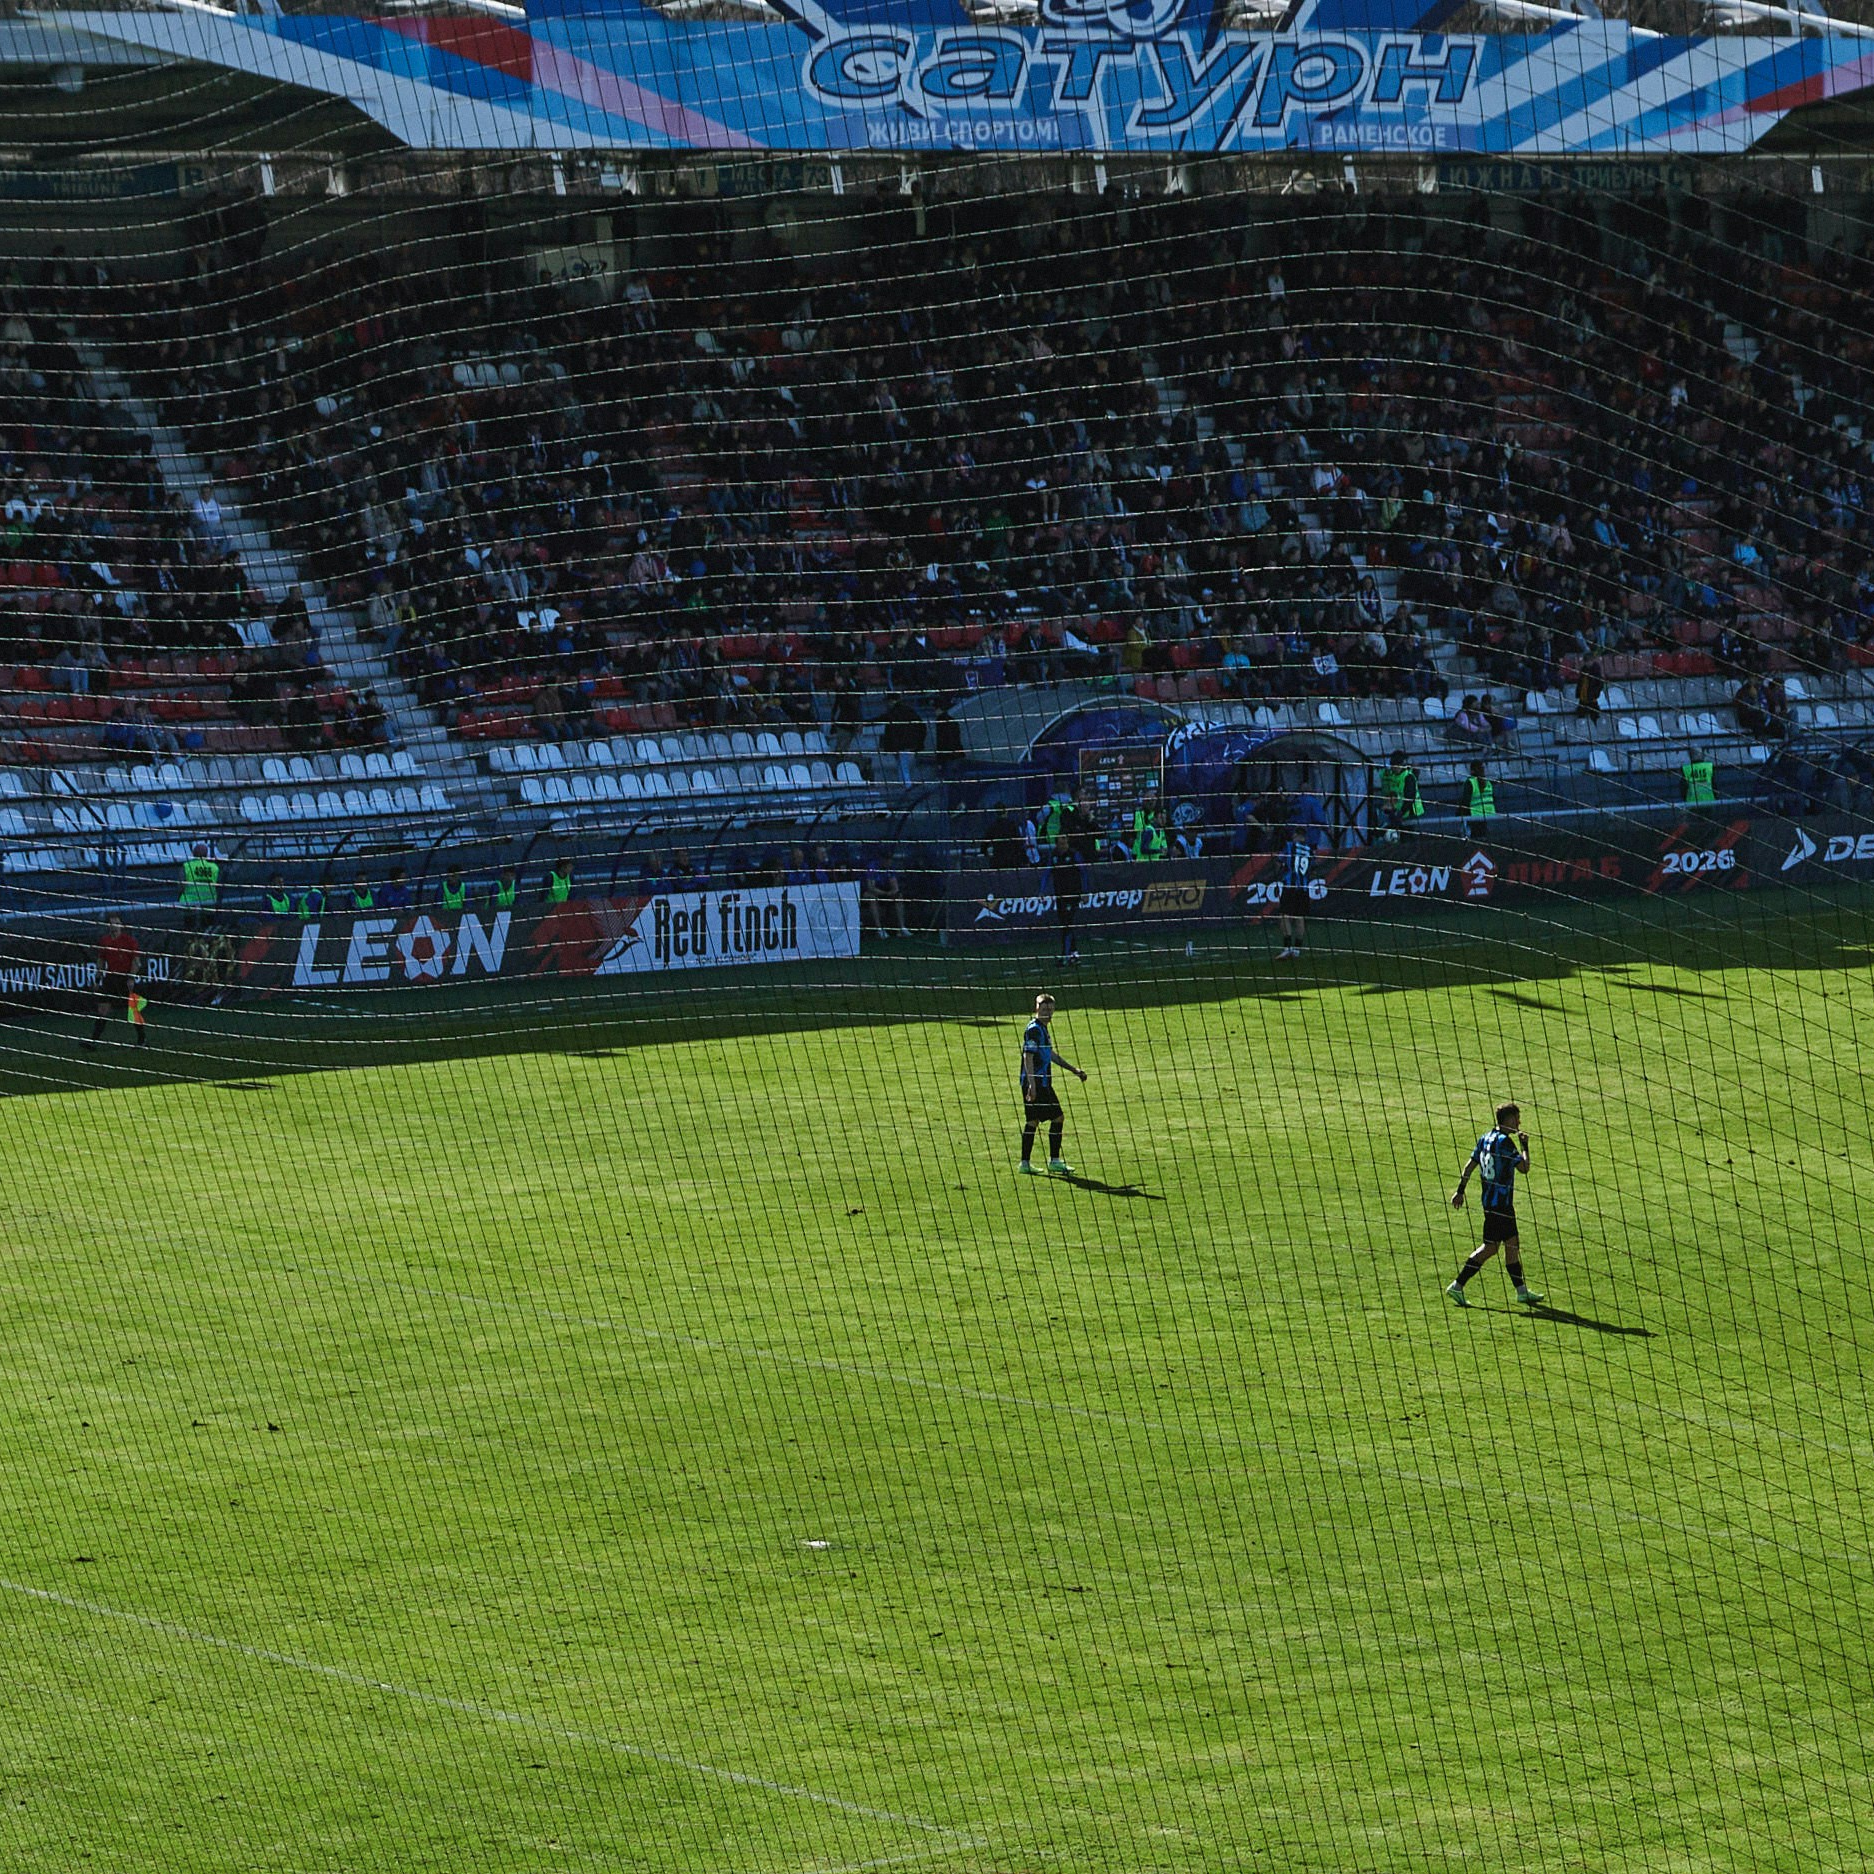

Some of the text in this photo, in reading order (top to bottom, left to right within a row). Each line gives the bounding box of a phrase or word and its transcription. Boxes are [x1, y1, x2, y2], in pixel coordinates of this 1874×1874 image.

[866, 118, 1059, 143] ЖИВИ СПОРТОМ!
[1319, 123, 1446, 146] РАМЕНСКОЕ
[1661, 848, 1736, 875] 2026
[998, 888, 1143, 916] спорастер
[1246, 878, 1328, 904] 206
[653, 887, 798, 969] Red finch
